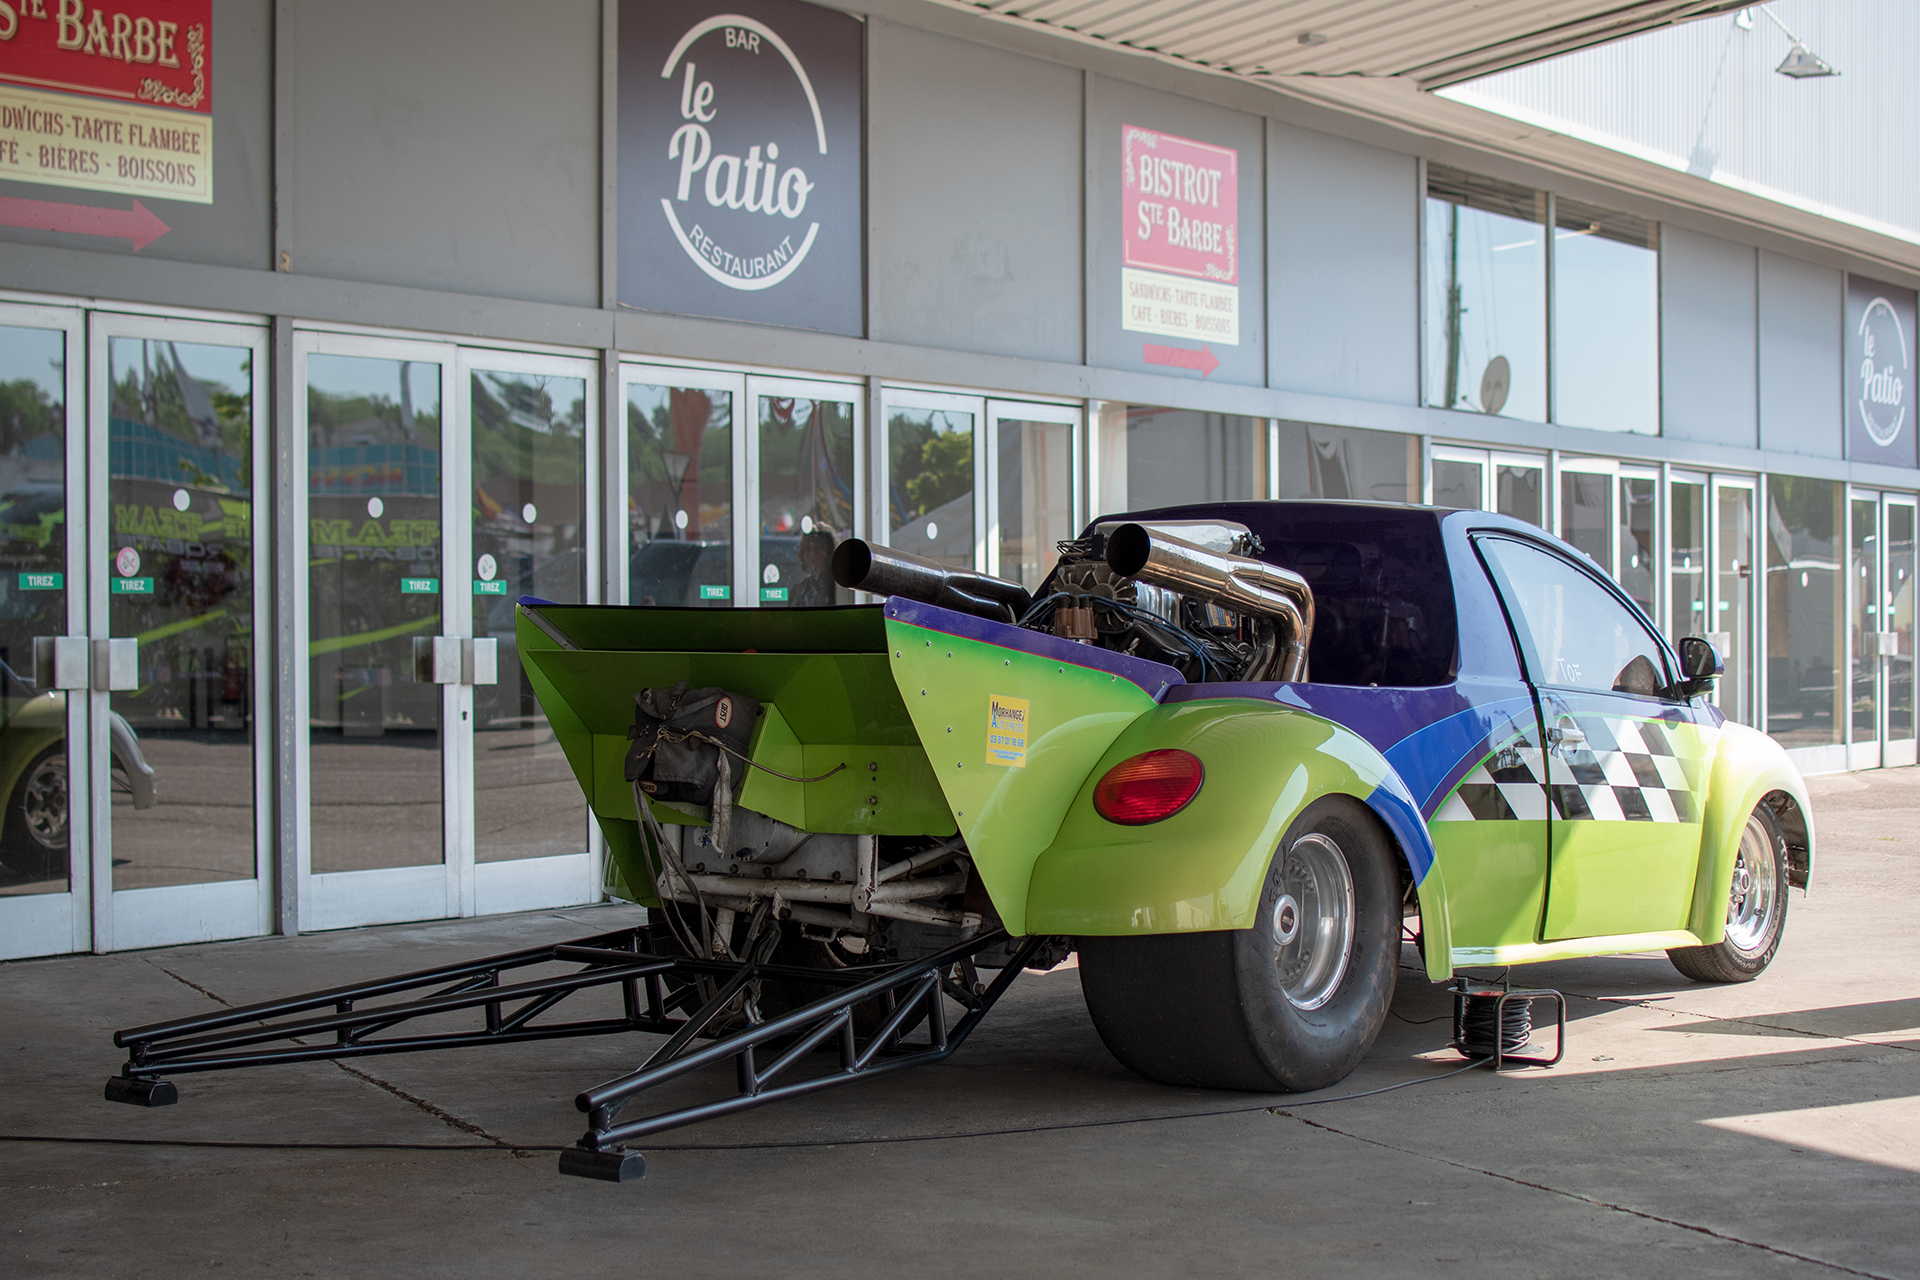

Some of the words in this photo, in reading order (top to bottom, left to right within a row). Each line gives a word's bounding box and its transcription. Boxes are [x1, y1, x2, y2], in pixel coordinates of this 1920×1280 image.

[56, 0, 181, 68] BARBE
[725, 27, 760, 54] BAR
[681, 62, 717, 123] le
[129, 123, 201, 155] FLAMBÉE
[39, 142, 100, 175] BIÈRES
[118, 154, 196, 188] BOISSONS
[669, 123, 815, 219] Patio
[1139, 154, 1222, 209] BISTROT
[1167, 206, 1223, 255] BARBE
[689, 224, 794, 278] RESTAURANT
[1864, 325, 1876, 357] le
[1860, 358, 1904, 406] Patio
[28, 575, 54, 587] TIREZ
[120, 580, 145, 591] TIREZ
[408, 580, 431, 591] TIREZ
[480, 582, 500, 593] TIREZ
[706, 587, 724, 597] TIREZ
[765, 589, 782, 599] TIREZ
